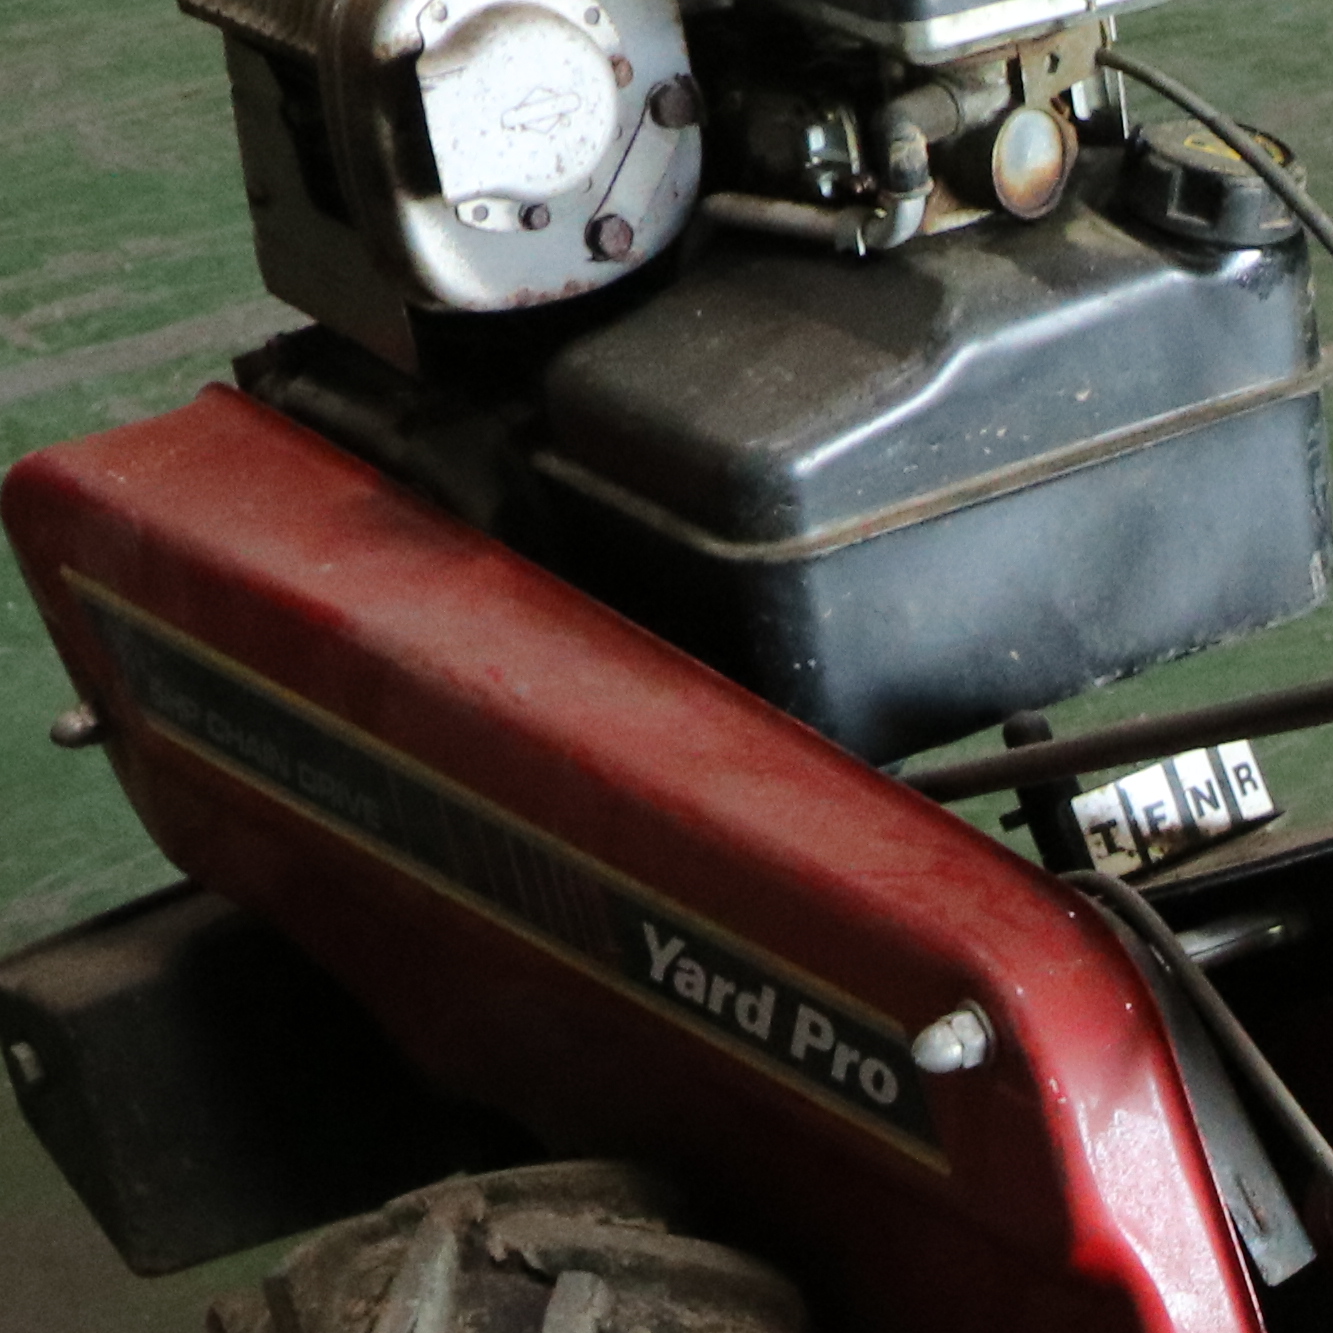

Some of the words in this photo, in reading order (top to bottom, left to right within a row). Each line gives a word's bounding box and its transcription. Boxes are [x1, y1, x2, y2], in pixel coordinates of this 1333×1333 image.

[206, 709, 297, 785] CHAIN
[302, 761, 391, 837] DRIVE
[1186, 778, 1221, 817] N
[1231, 761, 1260, 797] R
[643, 920, 777, 1041] Yard
[790, 1002, 899, 1104] Pro
